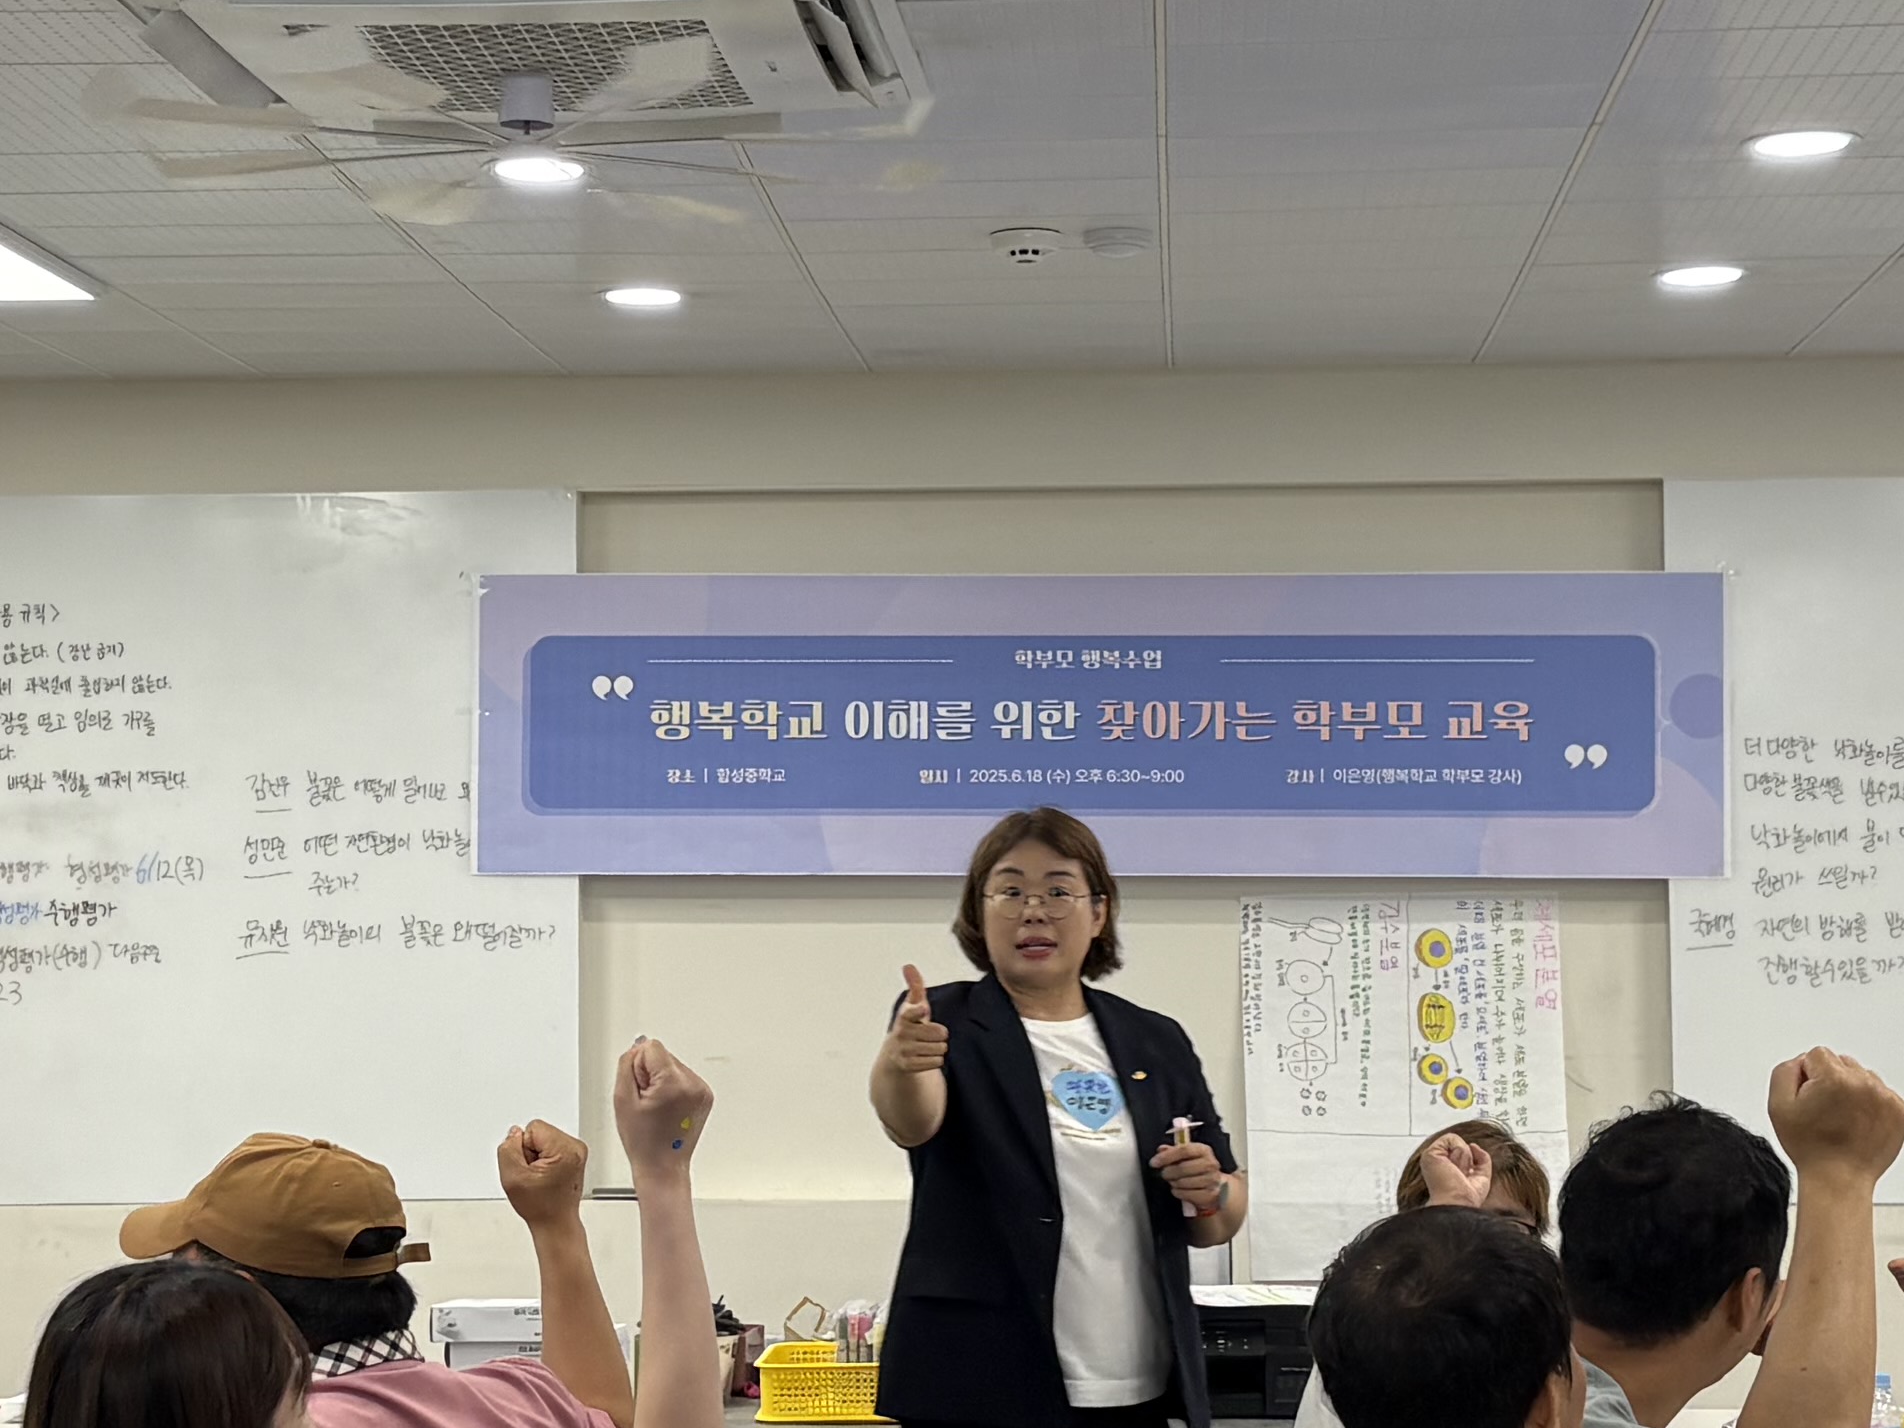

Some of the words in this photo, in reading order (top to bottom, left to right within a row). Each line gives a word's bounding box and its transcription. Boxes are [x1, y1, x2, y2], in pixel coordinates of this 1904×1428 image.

[1014, 649, 1076, 670] 학부모
[1081, 649, 1162, 670] 행복수업
[74, 709, 113, 733] 임의로
[649, 699, 828, 741] 행복학교
[844, 699, 977, 741] 이해를
[990, 699, 1081, 741] 위한
[1096, 699, 1277, 741] 찾아가는
[1292, 699, 1428, 741] 학부모
[1442, 699, 1535, 741] 교육
[1767, 736, 1818, 764] 다양한
[306, 770, 346, 807] 불꽃은
[666, 768, 696, 785] 장소
[919, 768, 949, 785] 일시
[969, 767, 1043, 785] 2025.6.18
[1047, 768, 1072, 786] (수)
[1074, 768, 1104, 785] 오후
[1106, 768, 1185, 785] 6:30~9:00
[1285, 768, 1315, 785] 강사
[1441, 768, 1486, 785] 학부모
[1488, 768, 1524, 787] 강사)
[303, 832, 339, 857] 어떤
[1751, 865, 1805, 899] 원리가
[43, 897, 119, 928] 수행평가
[399, 914, 445, 949] 불꽃은
[1755, 912, 1811, 942] 자연의
[1817, 910, 1869, 944] 방해를
